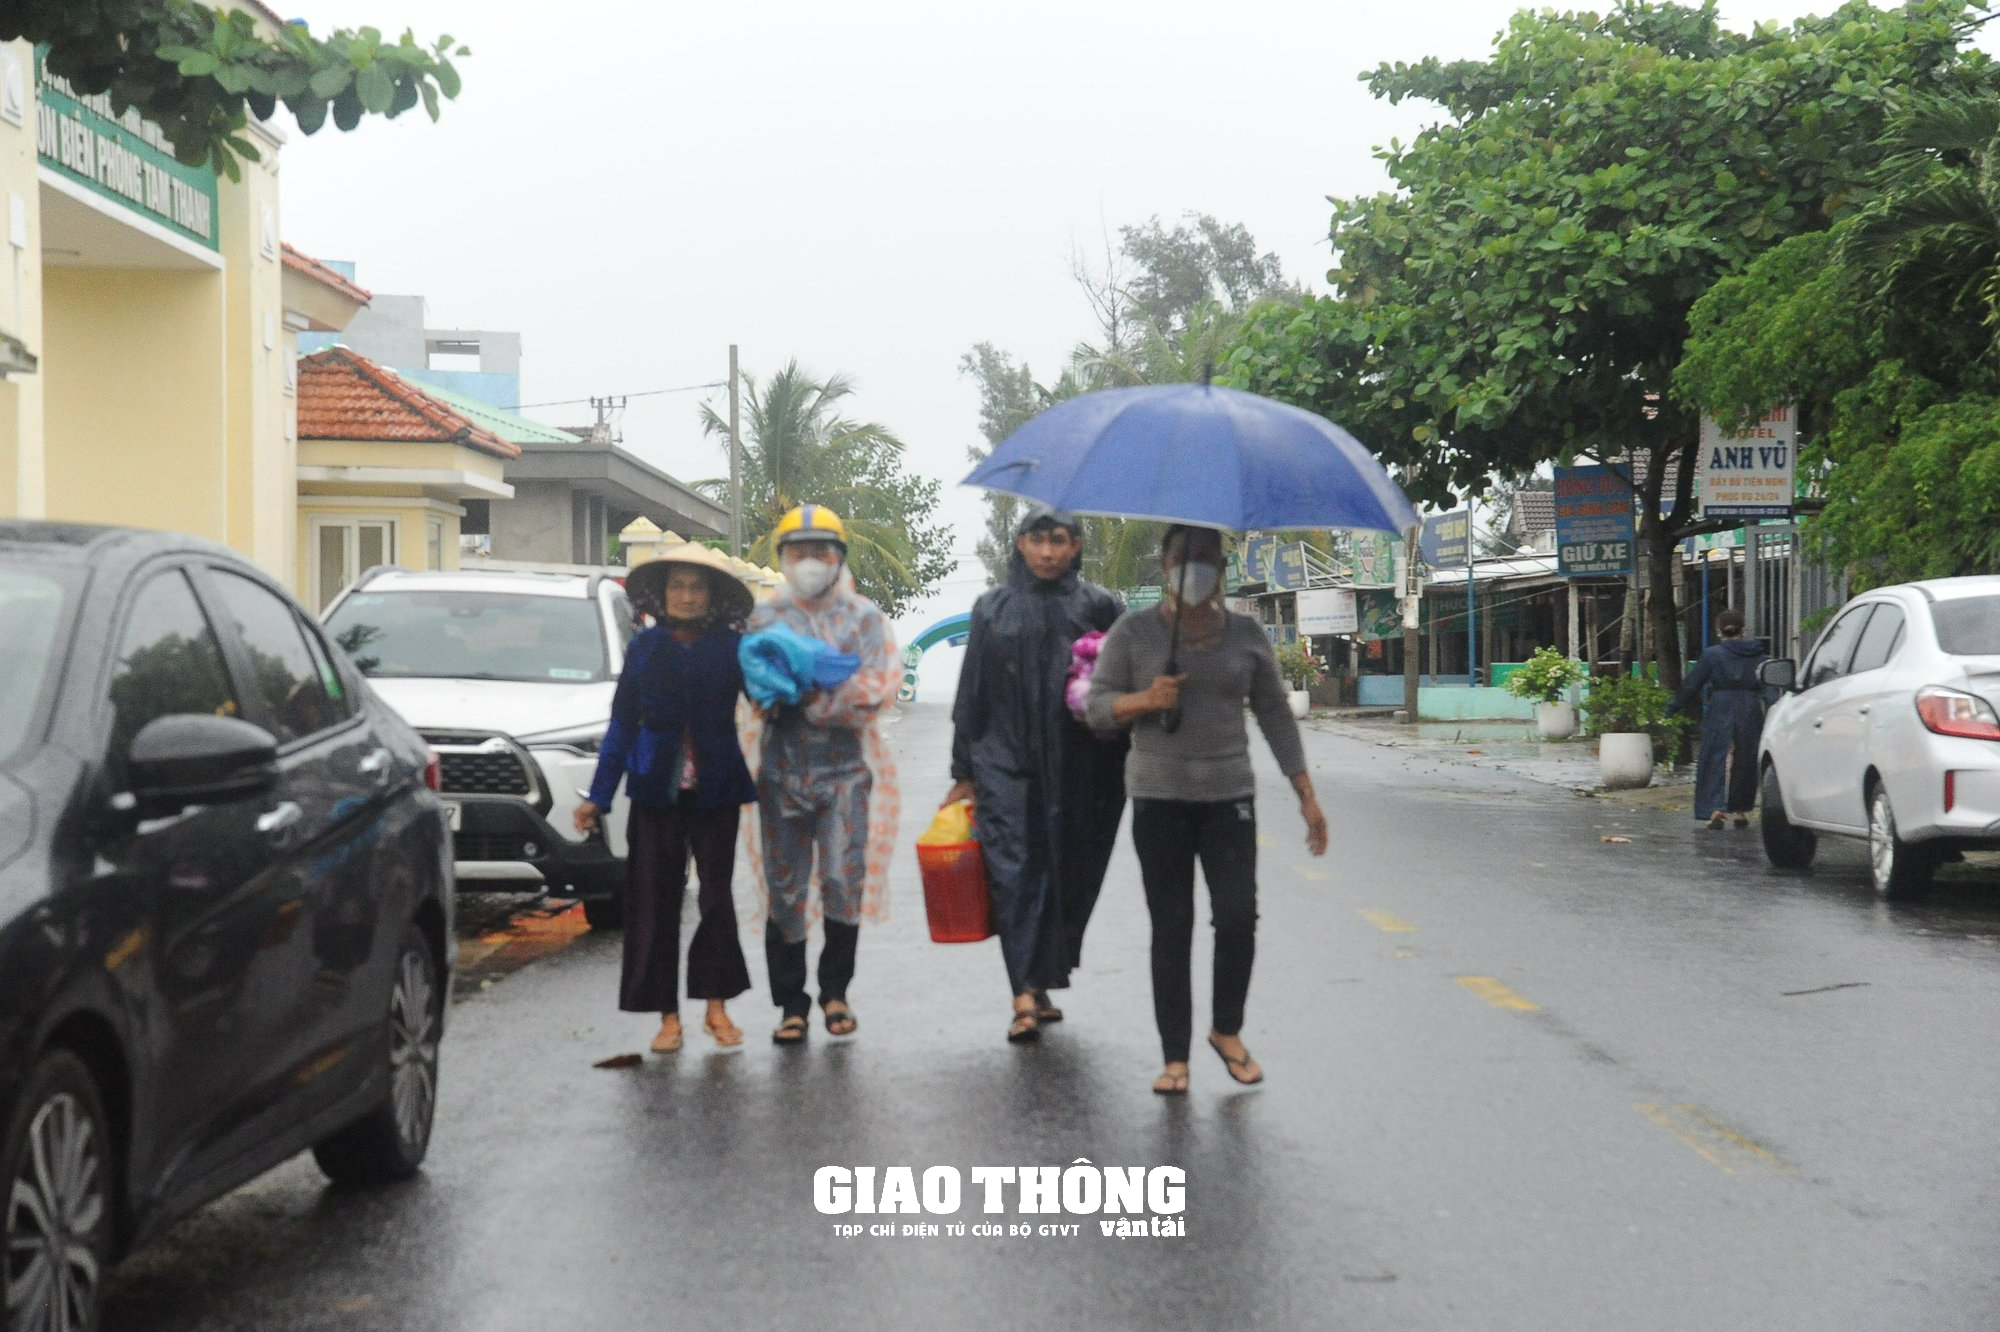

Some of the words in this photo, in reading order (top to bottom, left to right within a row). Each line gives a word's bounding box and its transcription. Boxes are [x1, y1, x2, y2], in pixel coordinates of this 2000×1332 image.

[172, 177, 211, 239] THANH
[1723, 428, 1776, 439] OTEL
[1710, 446, 1754, 469] ANH
[1759, 440, 1788, 469] VŨ
[1562, 542, 1598, 562] GIỮ
[1601, 542, 1627, 560] XE
